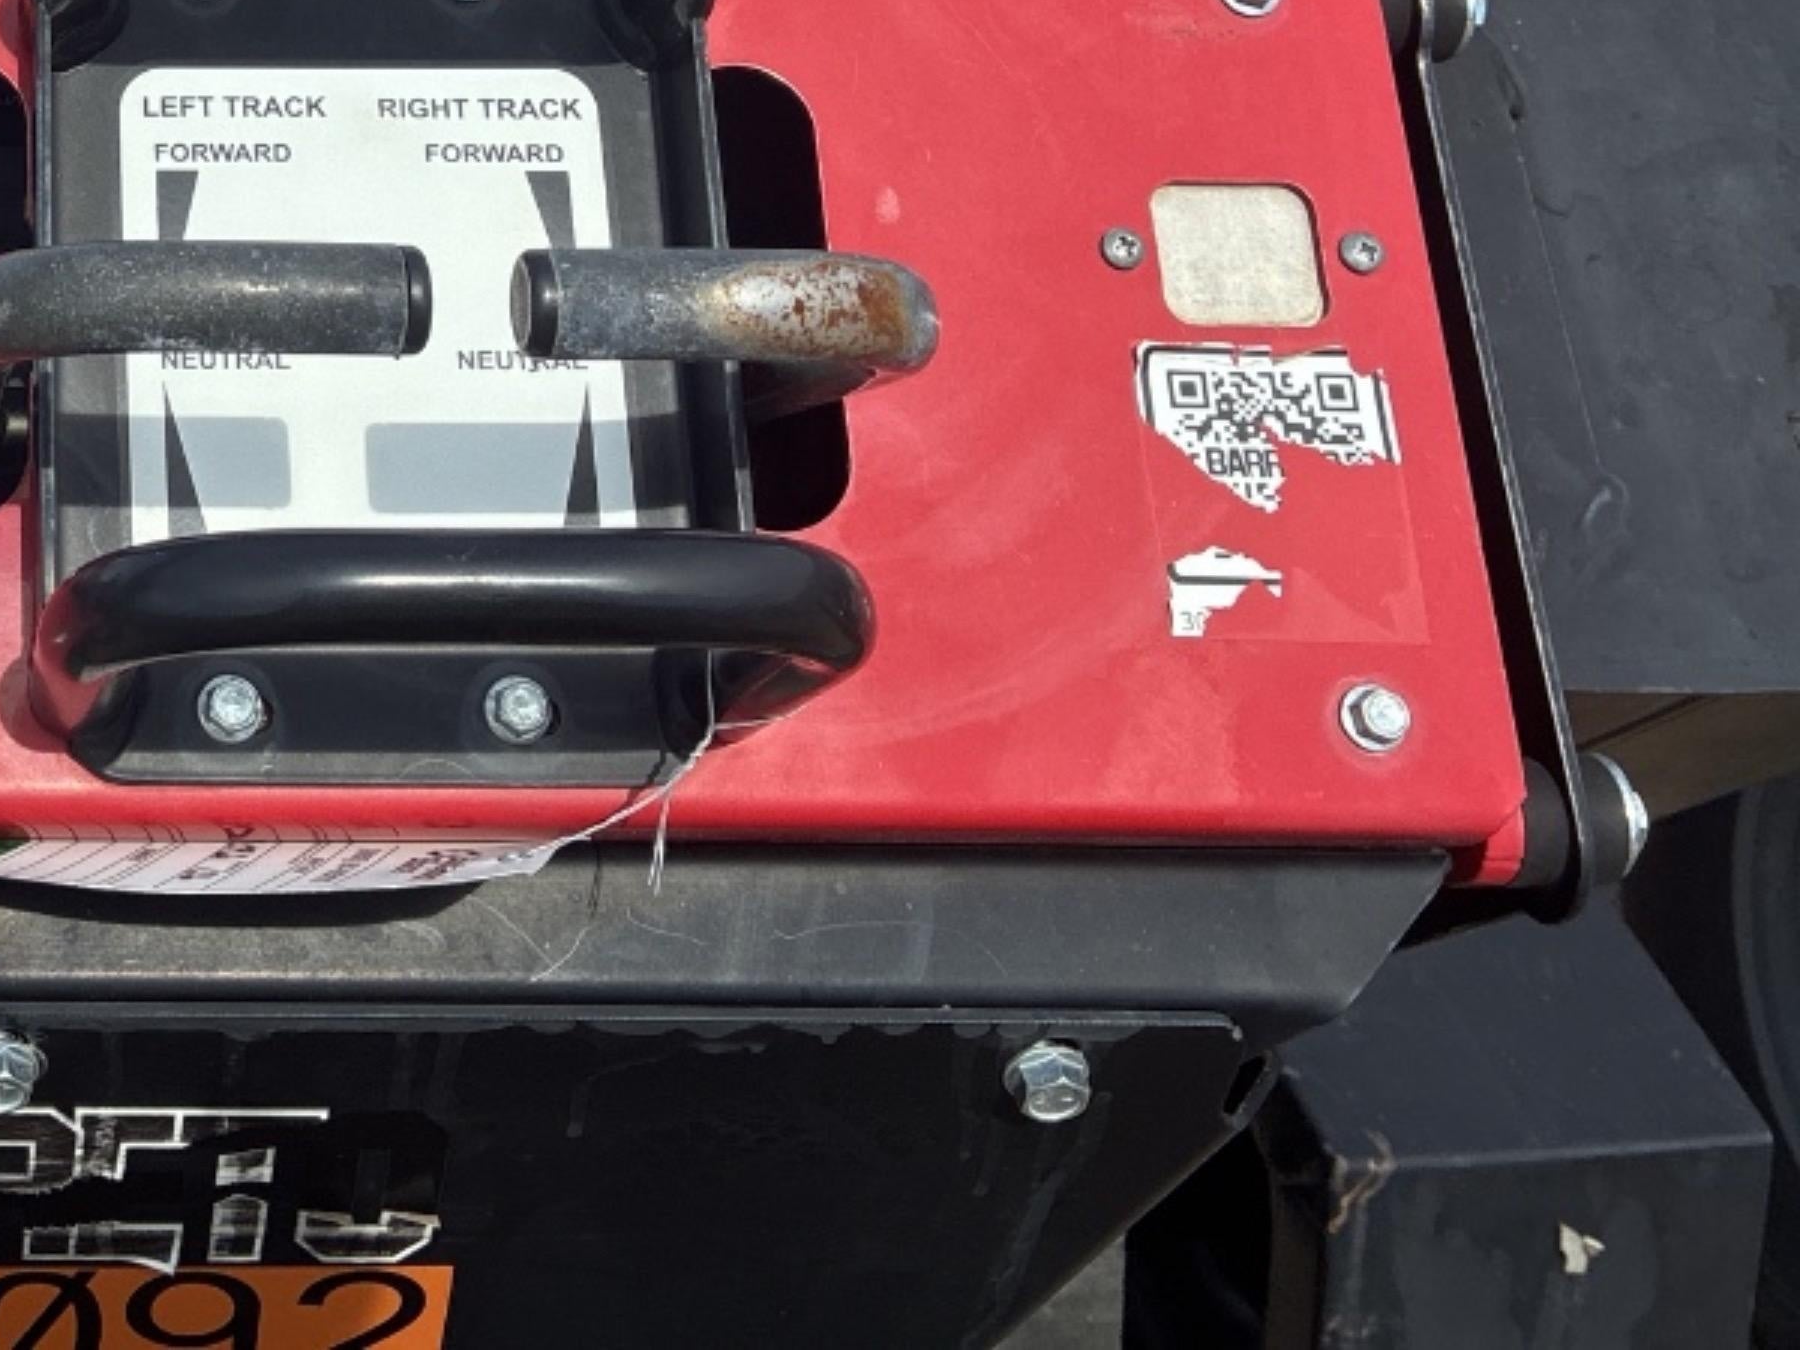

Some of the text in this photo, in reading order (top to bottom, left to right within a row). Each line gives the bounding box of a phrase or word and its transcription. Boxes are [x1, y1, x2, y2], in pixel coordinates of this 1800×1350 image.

[143, 96, 326, 119] LEFT TRACK
[378, 98, 582, 120] RIGHT TRACK
[155, 144, 292, 163] FORWARD
[425, 144, 565, 163] FORWARD
[161, 350, 292, 371] NEUTRAL
